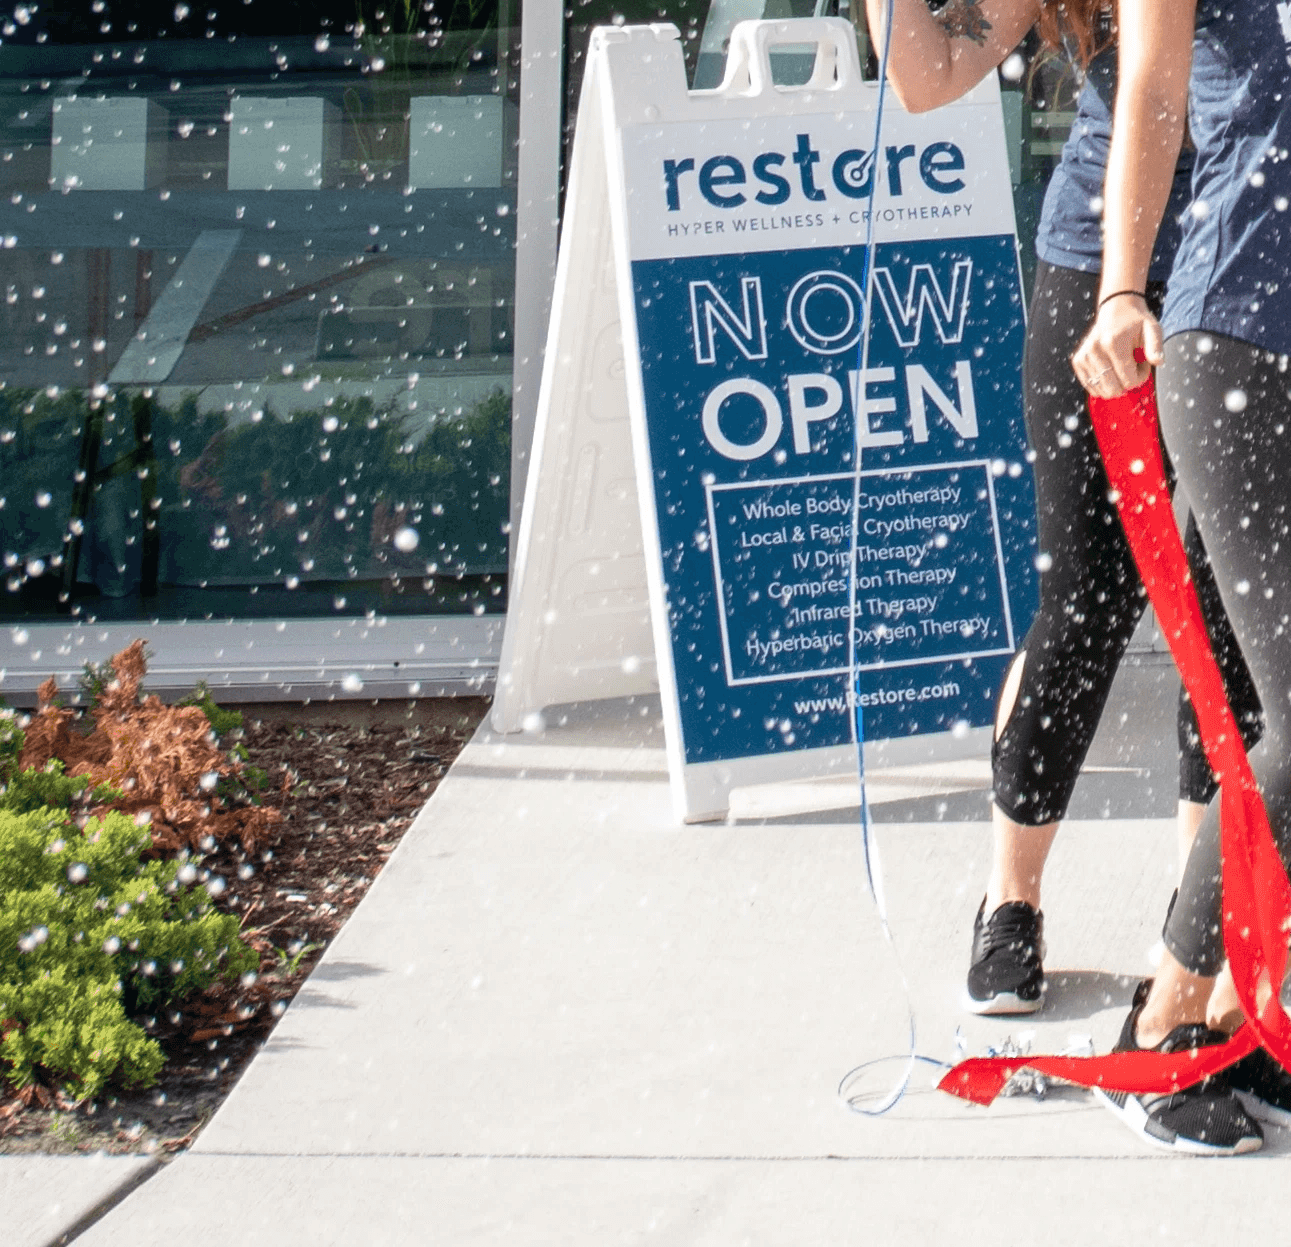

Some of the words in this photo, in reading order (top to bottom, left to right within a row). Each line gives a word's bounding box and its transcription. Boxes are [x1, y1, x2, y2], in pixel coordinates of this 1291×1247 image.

[662, 133, 967, 212] restore
[667, 220, 726, 238] HYPER
[732, 213, 825, 233] WELLNESS
[848, 203, 974, 224] CRYOTHERAPY
[688, 260, 974, 365] NOW
[701, 359, 980, 462] OPEN
[742, 499, 802, 521] Whole
[805, 494, 852, 516] Body
[857, 486, 962, 512] Cryotherapy
[741, 526, 788, 549] Local
[791, 525, 806, 543] &
[809, 521, 859, 541] Facia
[863, 512, 970, 537] Cryotherapy
[792, 551, 811, 570] IV
[814, 549, 854, 570] Drip
[856, 543, 928, 564] Therapy
[767, 573, 883, 599] Compresion
[884, 566, 957, 587] Therapy
[792, 600, 863, 624] Infrared
[865, 595, 938, 618] Therapy
[746, 631, 844, 657] Hyperbaric
[848, 623, 917, 644] Oxygen
[919, 616, 991, 639] Therapy
